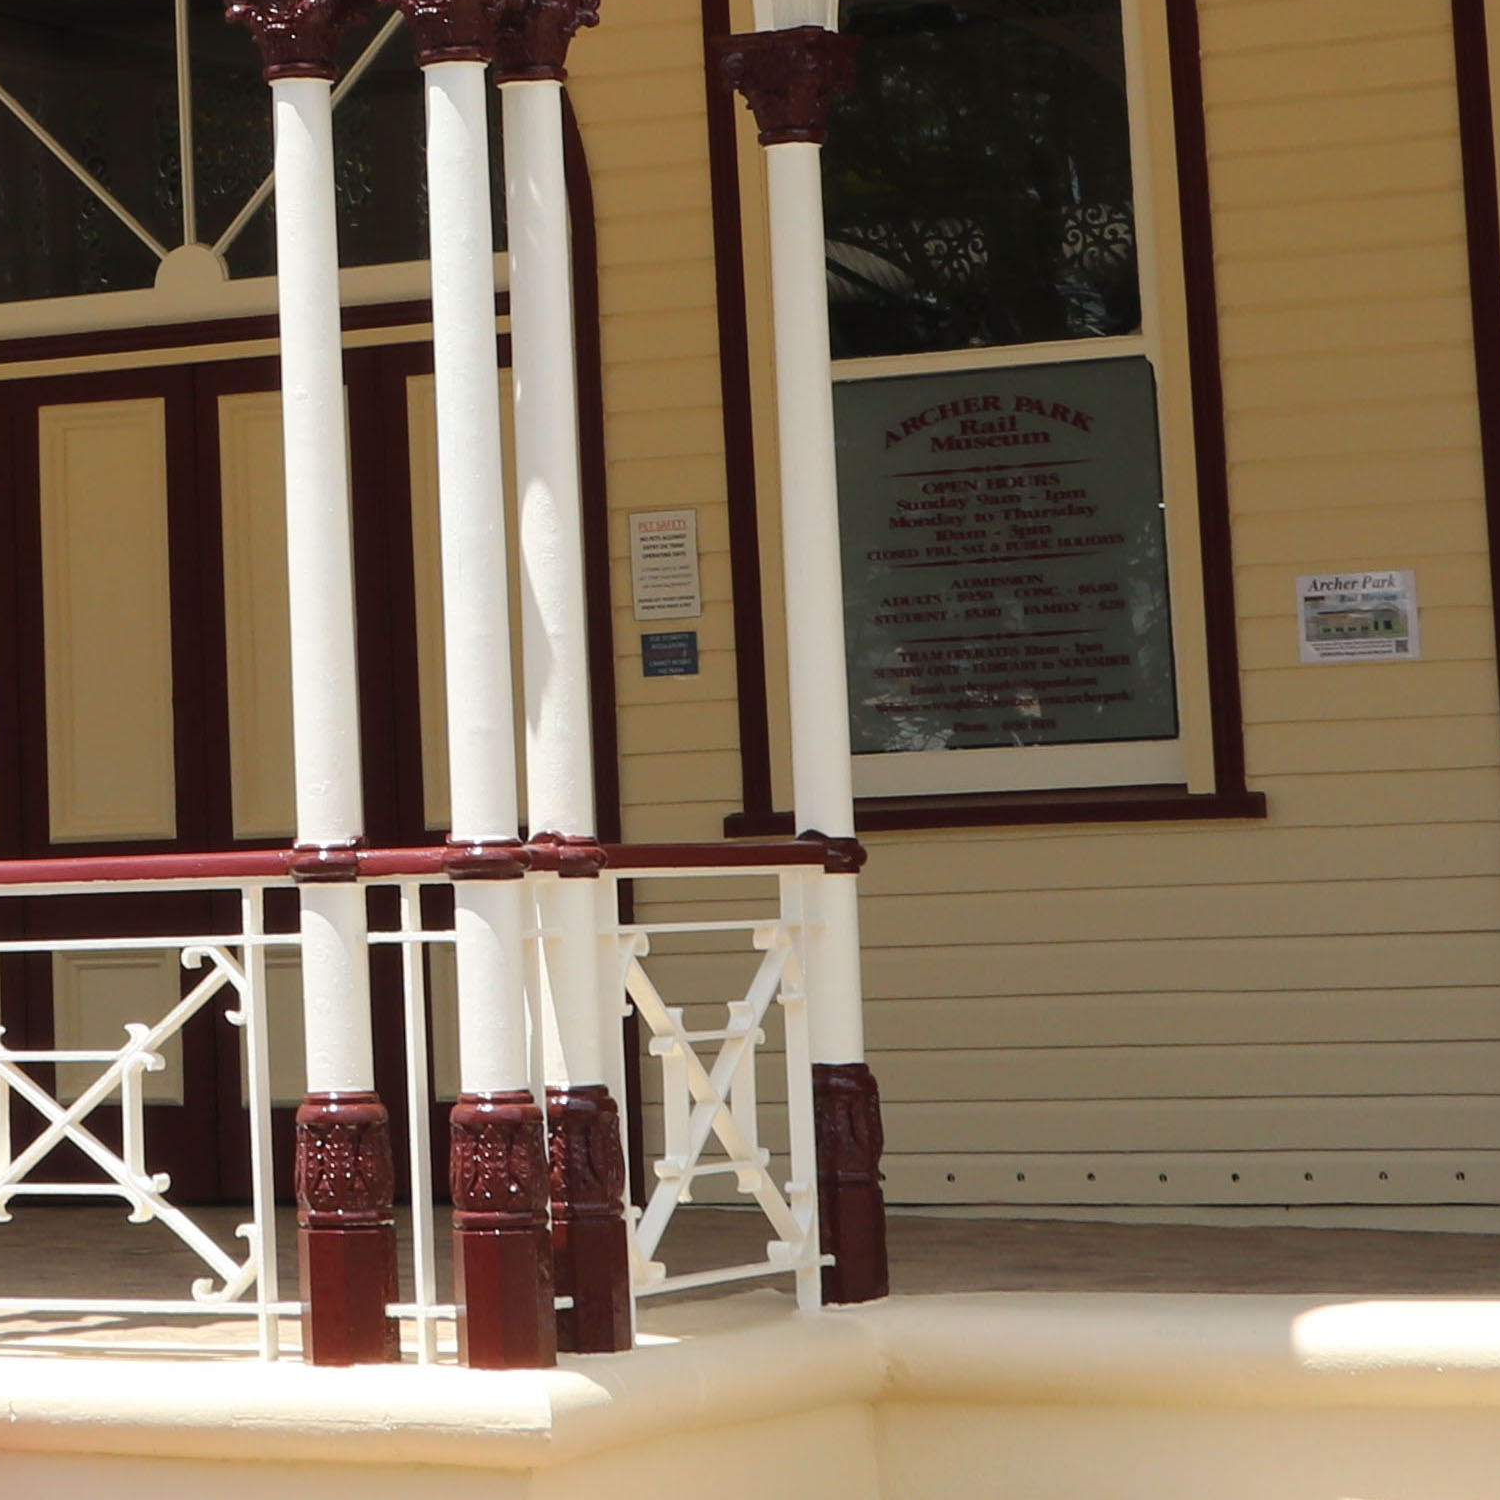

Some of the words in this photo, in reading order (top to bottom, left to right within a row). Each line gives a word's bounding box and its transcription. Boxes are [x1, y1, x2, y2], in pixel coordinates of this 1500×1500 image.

[884, 395, 1000, 450] ARCHER
[1014, 394, 1094, 437] PARK
[960, 415, 1017, 436] Rail
[929, 430, 1050, 452] Museum
[922, 479, 978, 495] OPEN
[986, 473, 1060, 490] HOURS
[896, 496, 969, 512] Sunday
[889, 515, 966, 530] Monday
[975, 512, 994, 523] to
[1003, 504, 1097, 522] Thursday
[1308, 577, 1358, 592] Archer
[1362, 574, 1396, 589] Park
